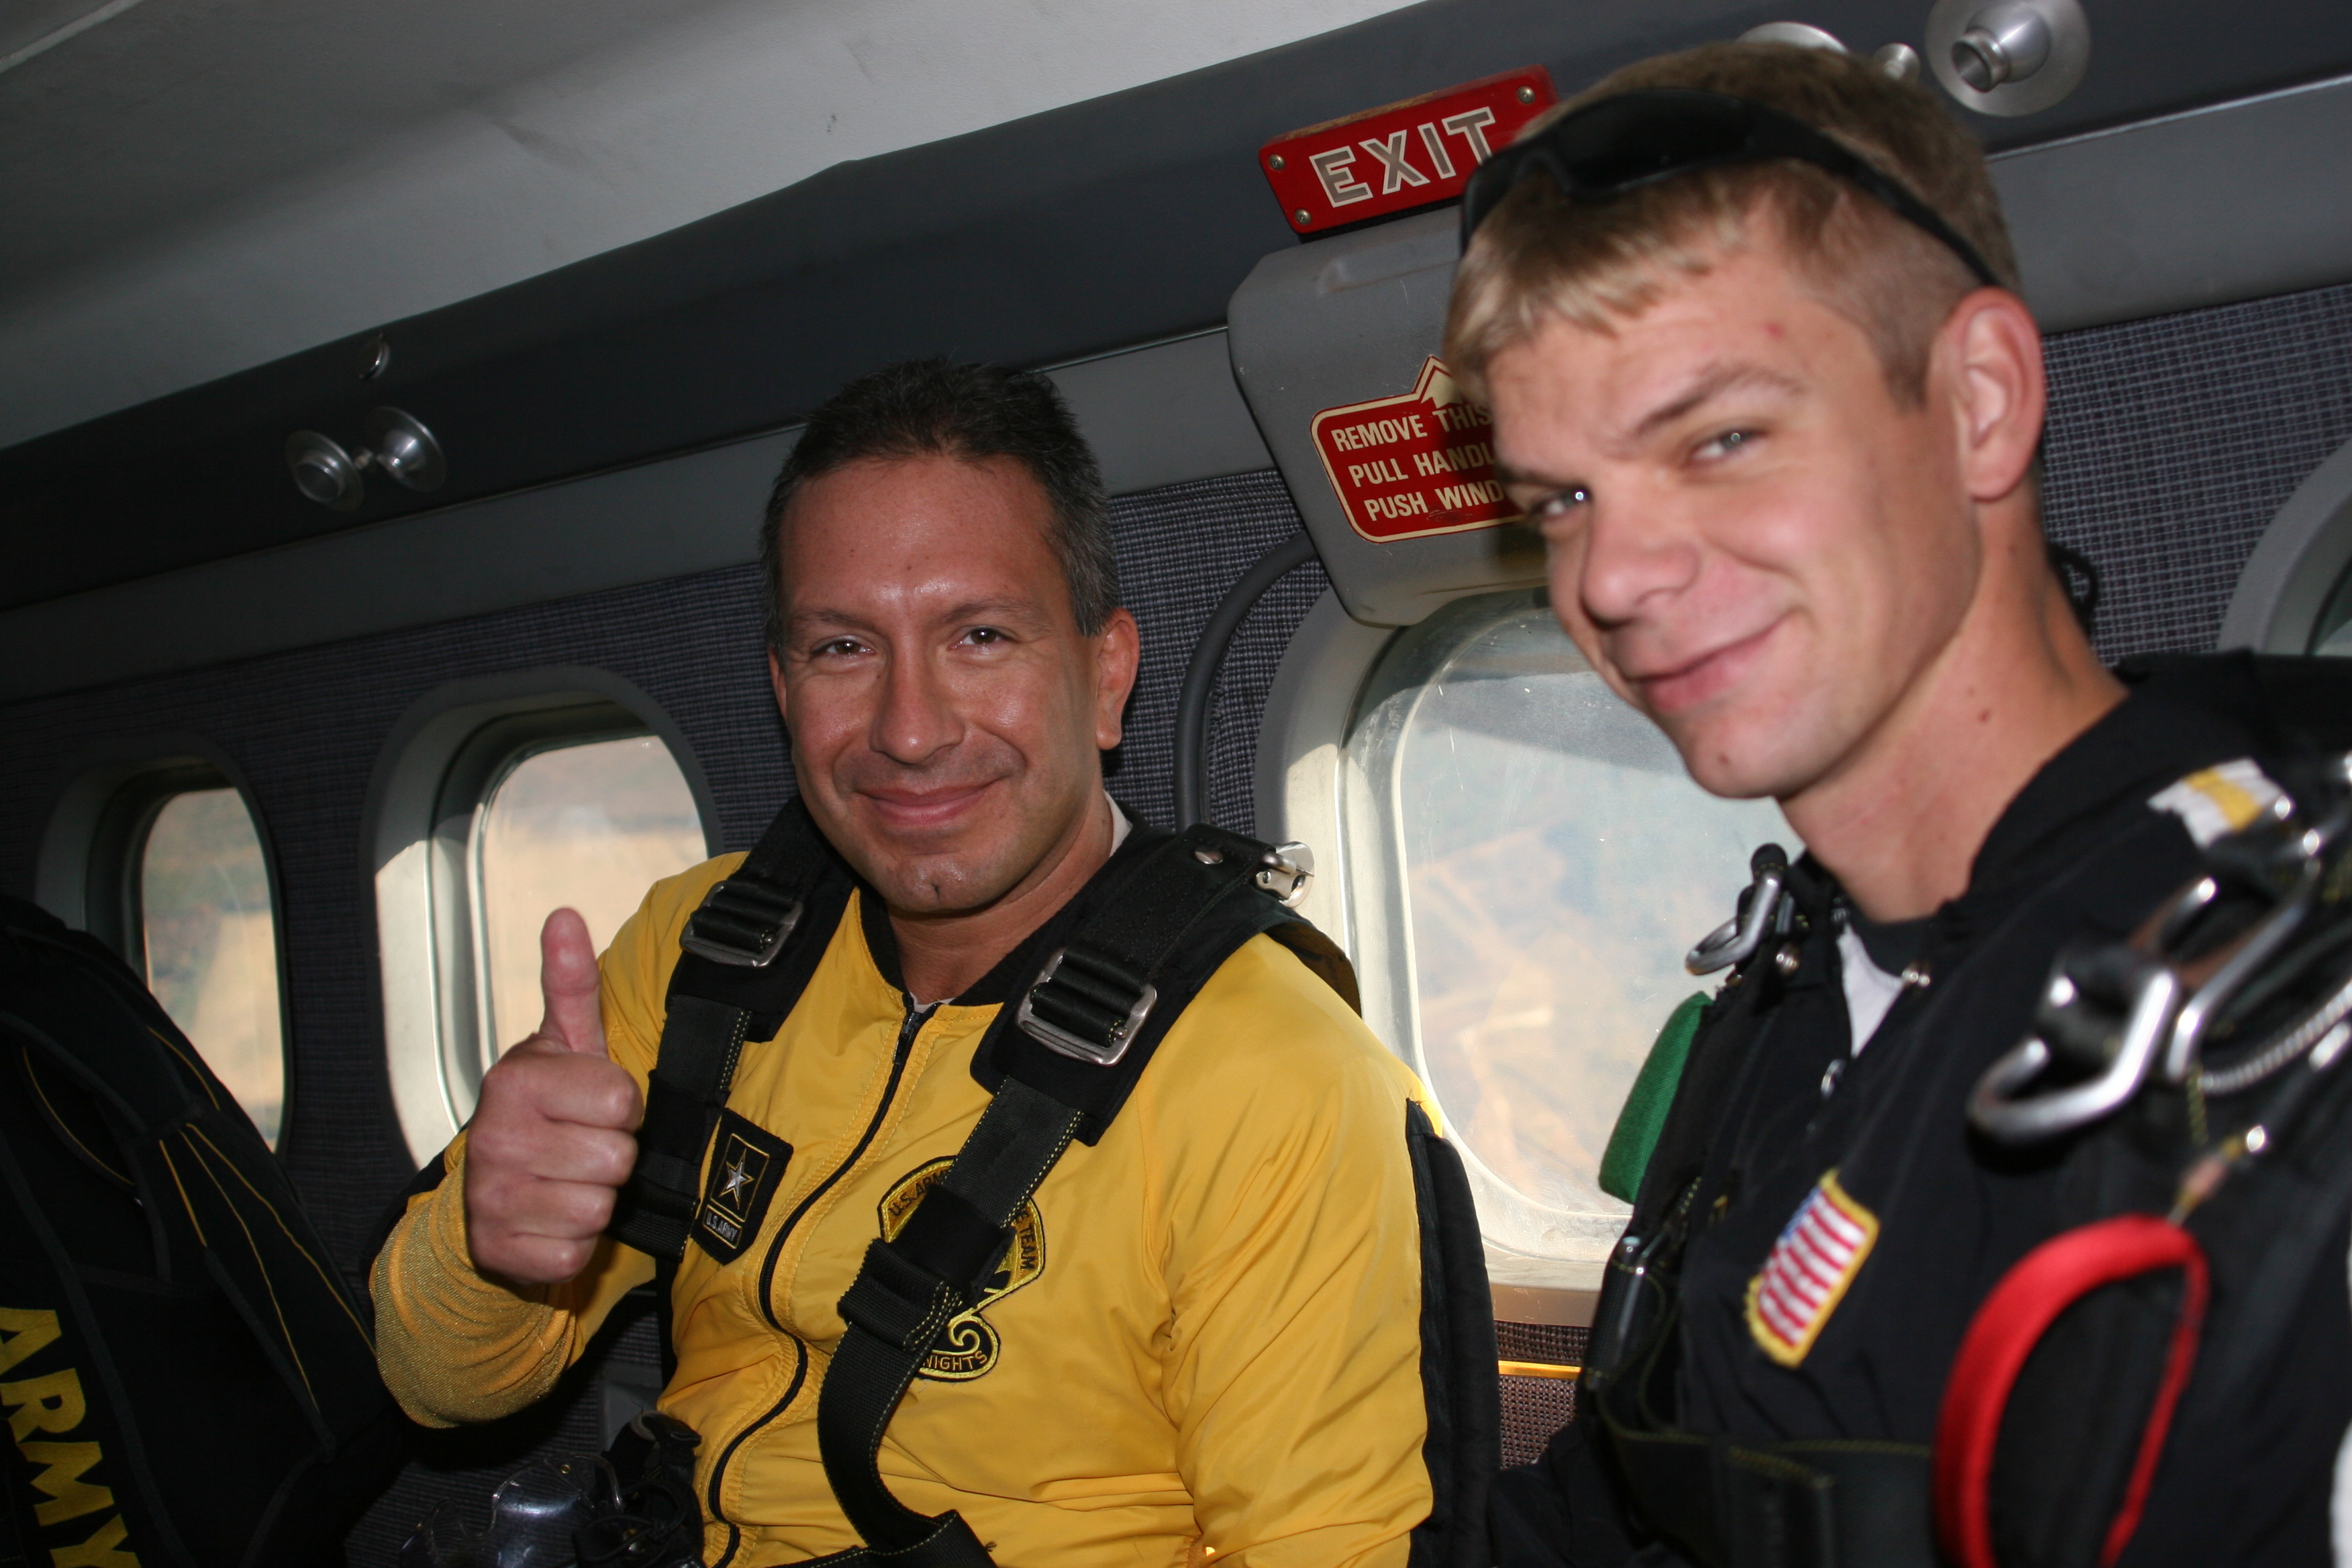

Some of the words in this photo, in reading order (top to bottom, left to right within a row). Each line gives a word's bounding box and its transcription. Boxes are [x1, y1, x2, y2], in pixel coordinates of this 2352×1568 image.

[1309, 106, 1496, 208] EXIT
[1331, 415, 1428, 452] REMOVE
[1432, 403, 1493, 432] THIS
[1348, 458, 1408, 487] PULL
[1412, 442, 1496, 477] HANDL
[1364, 491, 1428, 522] PUSH
[1434, 479, 1505, 510] WIND
[1020, 1223, 1036, 1269] TEAM
[922, 1350, 987, 1371] NIGHTS
[0, 1307, 142, 1568] ARMY
